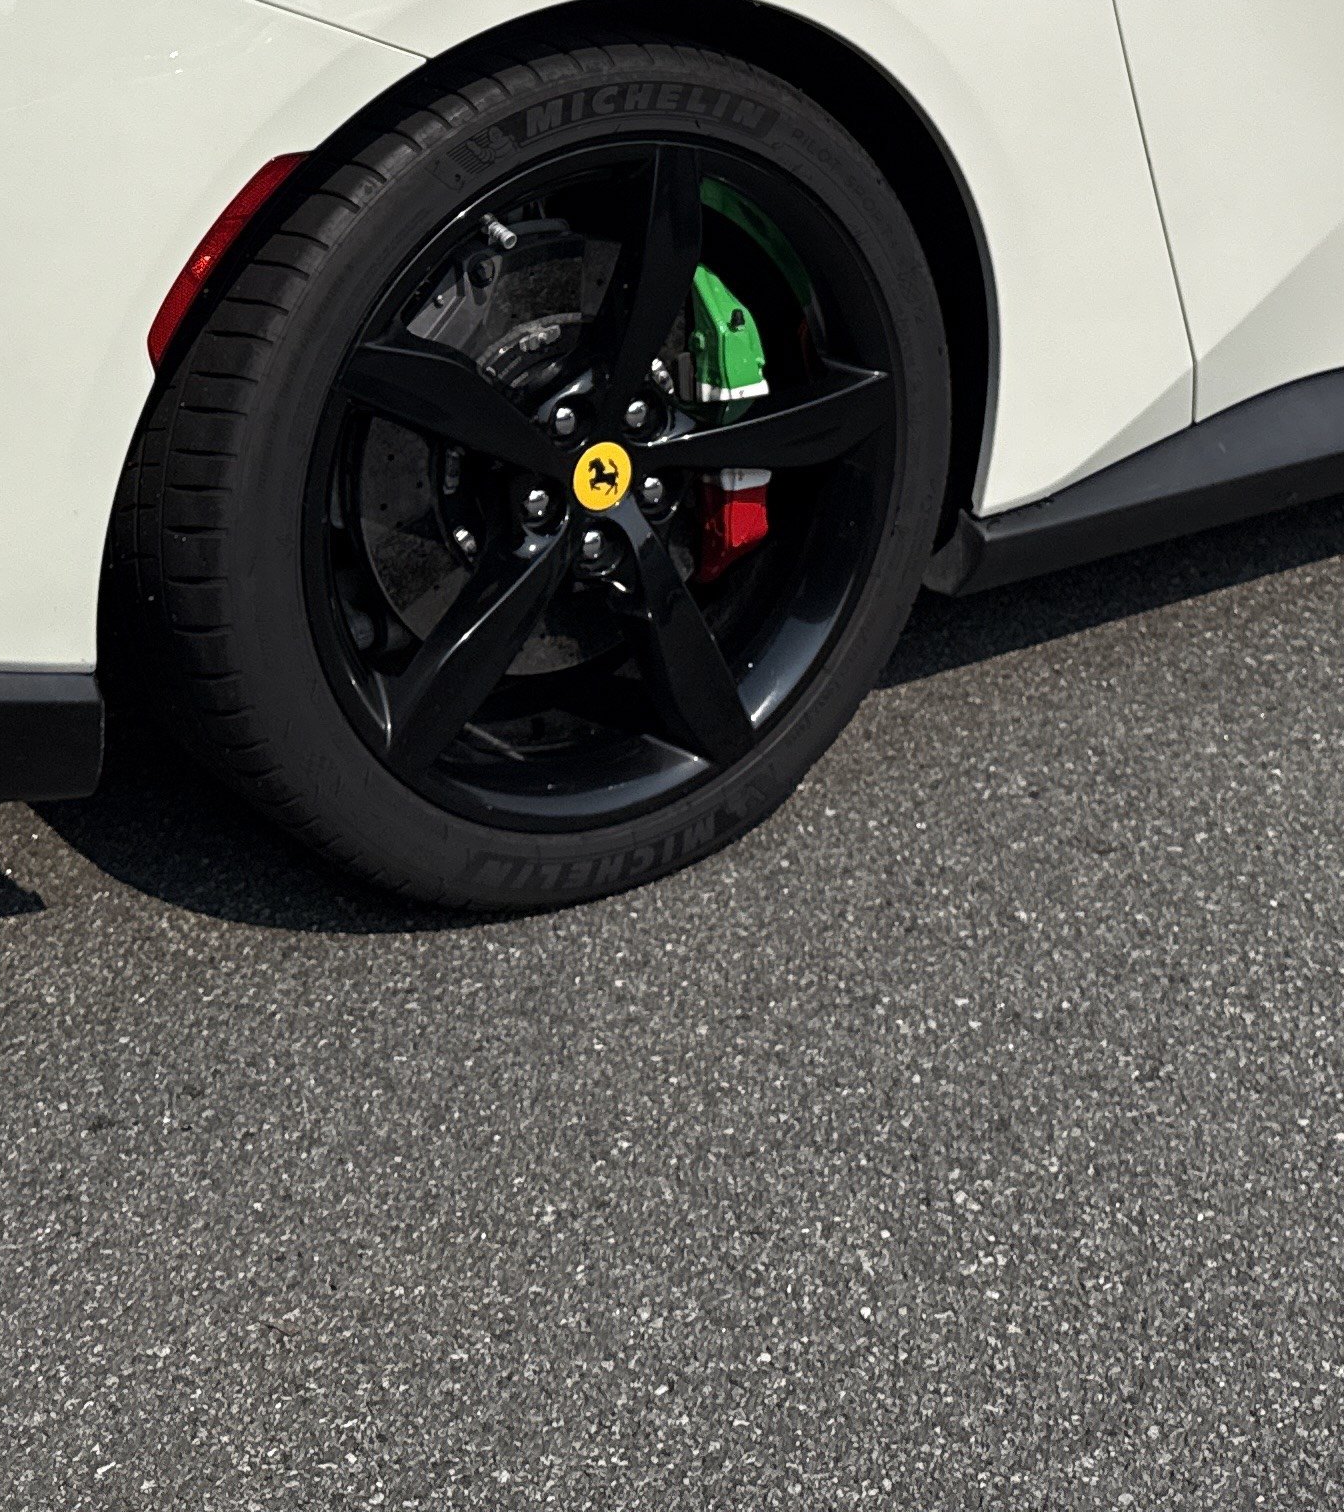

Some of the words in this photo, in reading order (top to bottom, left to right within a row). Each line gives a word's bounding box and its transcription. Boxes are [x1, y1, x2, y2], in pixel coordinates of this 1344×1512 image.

[525, 83, 766, 138] MICHELIN
[791, 128, 842, 170] PILOT
[472, 811, 717, 891] MICHELIN
